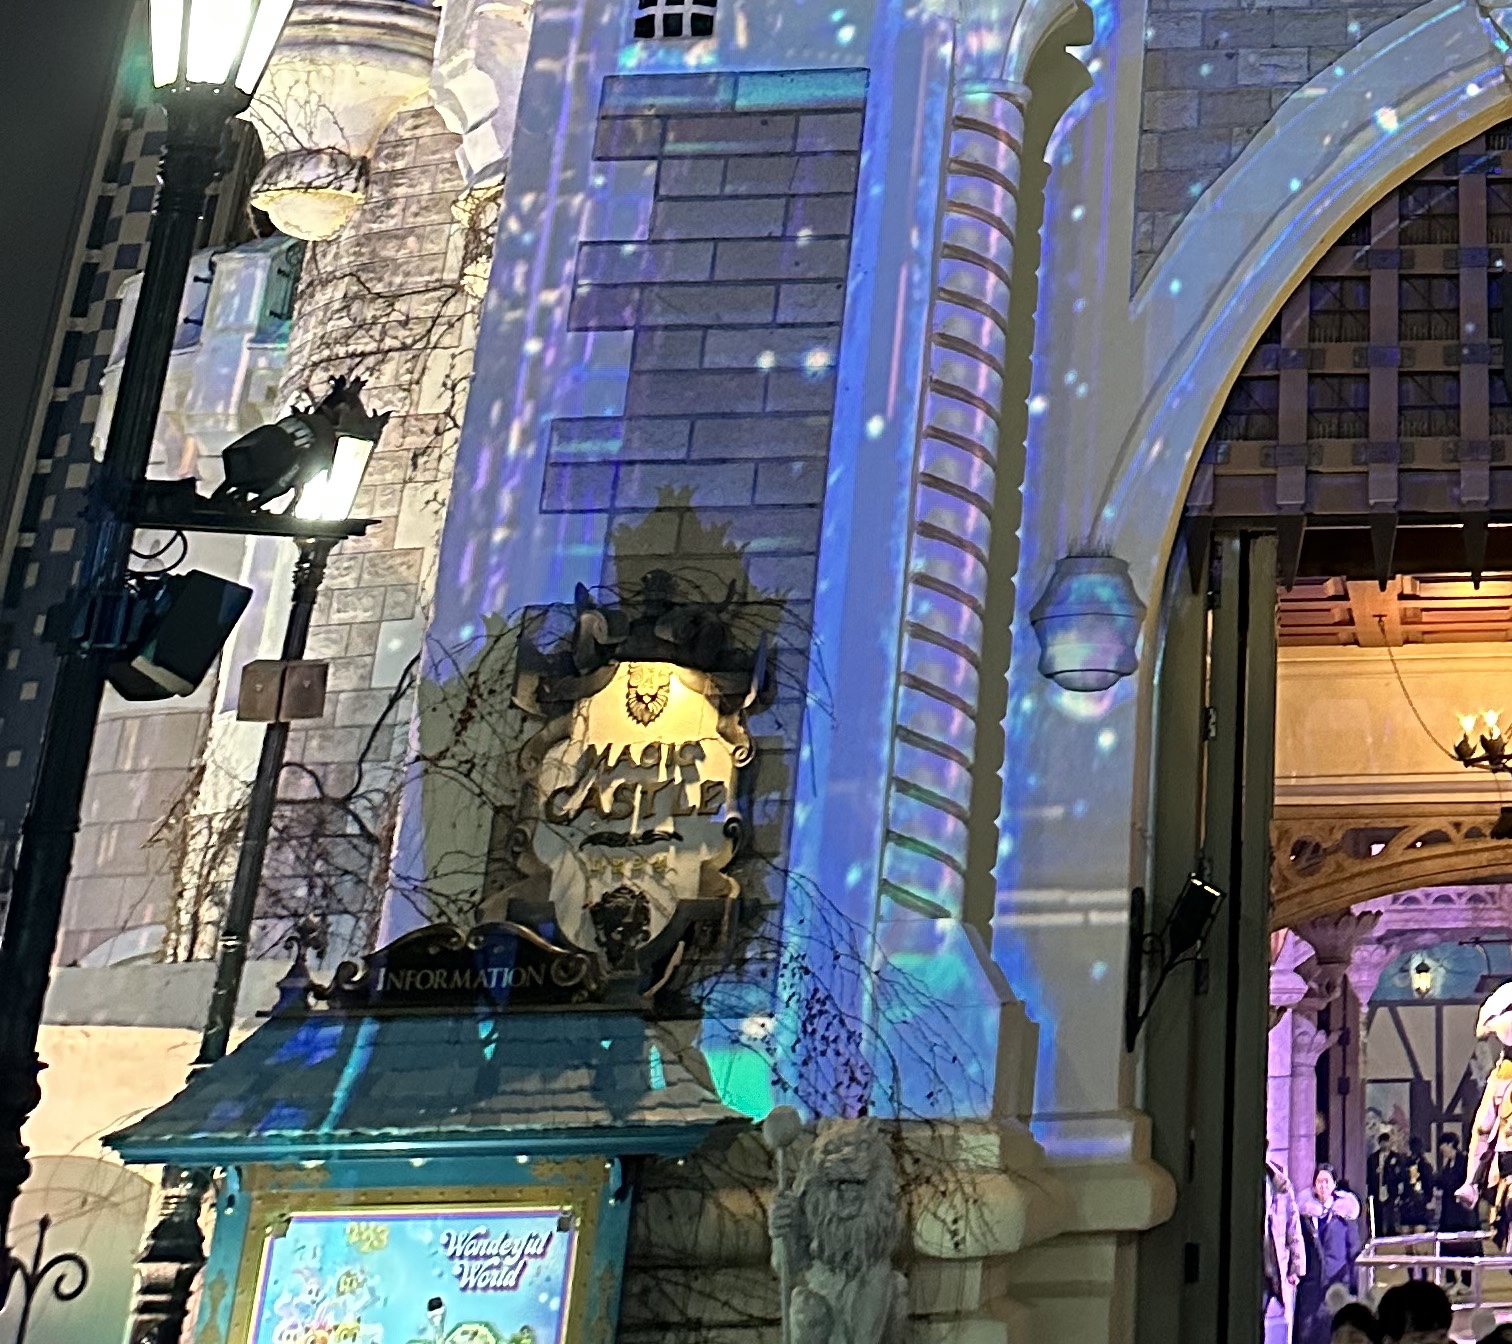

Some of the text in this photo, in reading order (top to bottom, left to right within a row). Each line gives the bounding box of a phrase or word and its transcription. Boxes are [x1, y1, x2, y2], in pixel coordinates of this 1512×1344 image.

[576, 740, 706, 773] MAGIC
[545, 778, 727, 826] CASTLE
[375, 964, 547, 991] INFORMATION
[439, 1225, 555, 1264] Wonderful
[452, 1258, 526, 1291] World
